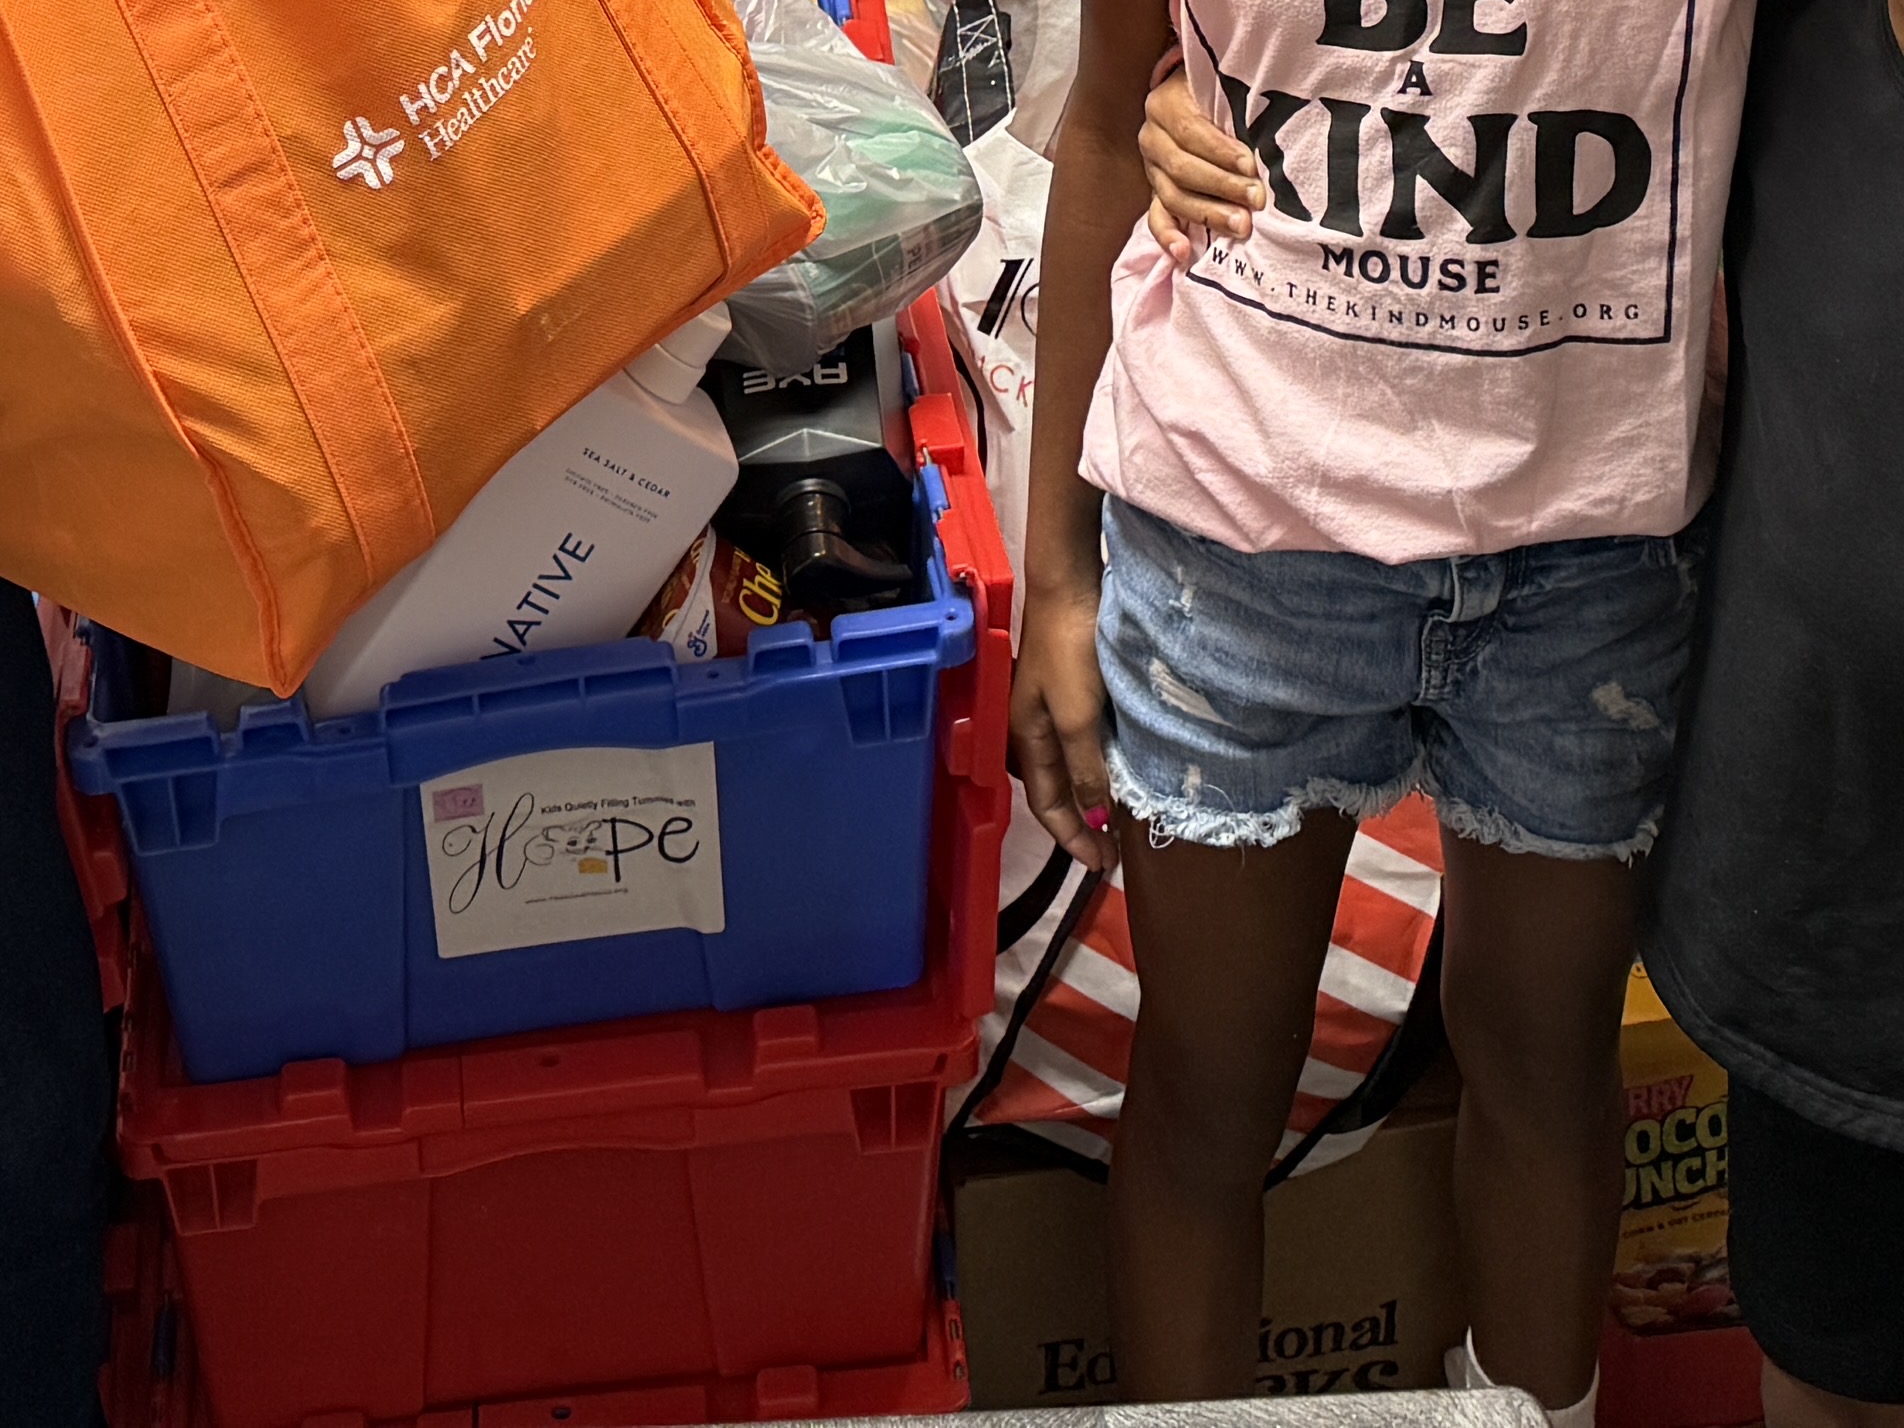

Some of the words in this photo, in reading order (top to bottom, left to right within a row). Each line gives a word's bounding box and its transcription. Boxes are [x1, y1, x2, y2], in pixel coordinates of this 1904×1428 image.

[399, 42, 478, 130] HCA
[417, 27, 542, 164] Healthcare
[1397, 60, 1433, 97] A
[1221, 76, 1653, 245] KIND
[1210, 246, 1642, 334] WWW.THEKINDMOUSE.ORG
[1320, 243, 1502, 294] MOUSE
[743, 361, 850, 396] AXE
[582, 447, 604, 467] SEA
[603, 457, 628, 479] SALT
[636, 474, 672, 500] CEDAR
[479, 532, 595, 662] NATIVE
[540, 804, 563, 815] Kids
[564, 799, 599, 814] Quietly
[600, 796, 630, 811] Filling
